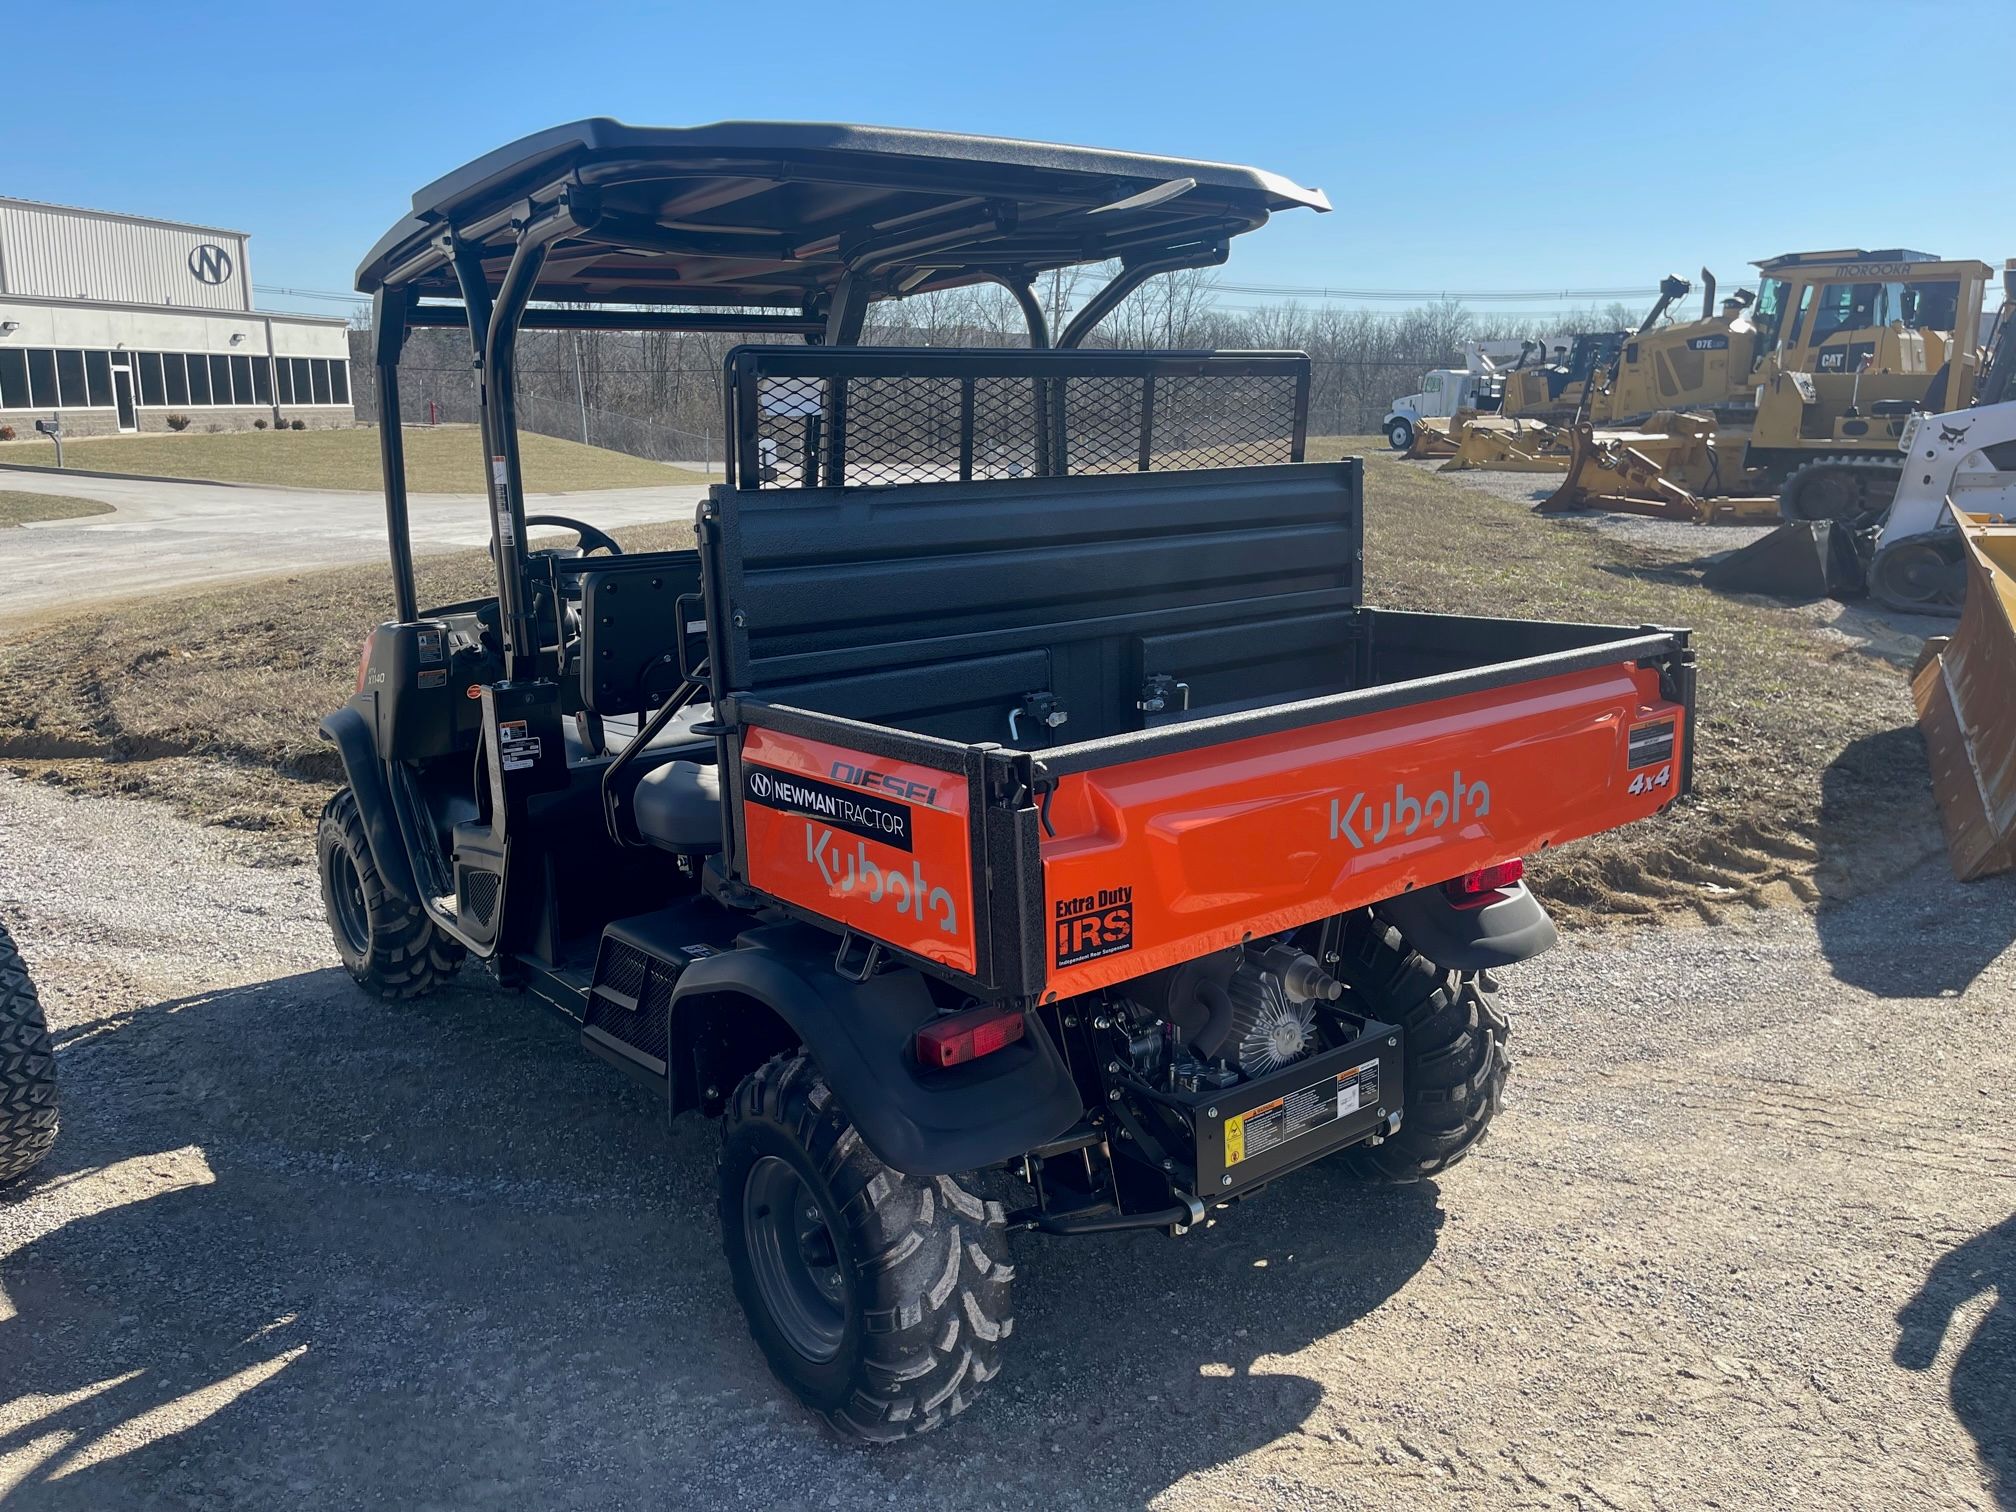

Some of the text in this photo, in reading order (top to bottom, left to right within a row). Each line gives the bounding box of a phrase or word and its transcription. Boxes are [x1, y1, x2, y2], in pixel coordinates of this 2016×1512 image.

[1835, 263, 1911, 277] MOROOKA
[1695, 339, 1712, 349] D7E
[1821, 353, 1844, 368] CAT
[1627, 765, 1671, 796] 4x4
[1330, 770, 1490, 849] Kubota
[805, 822, 957, 935] Kubota
[1055, 886, 1133, 919] Extra Duty
[1059, 909, 1131, 956] IRS
[1058, 953, 1090, 966] Independent
[1102, 943, 1130, 955] Suspension
